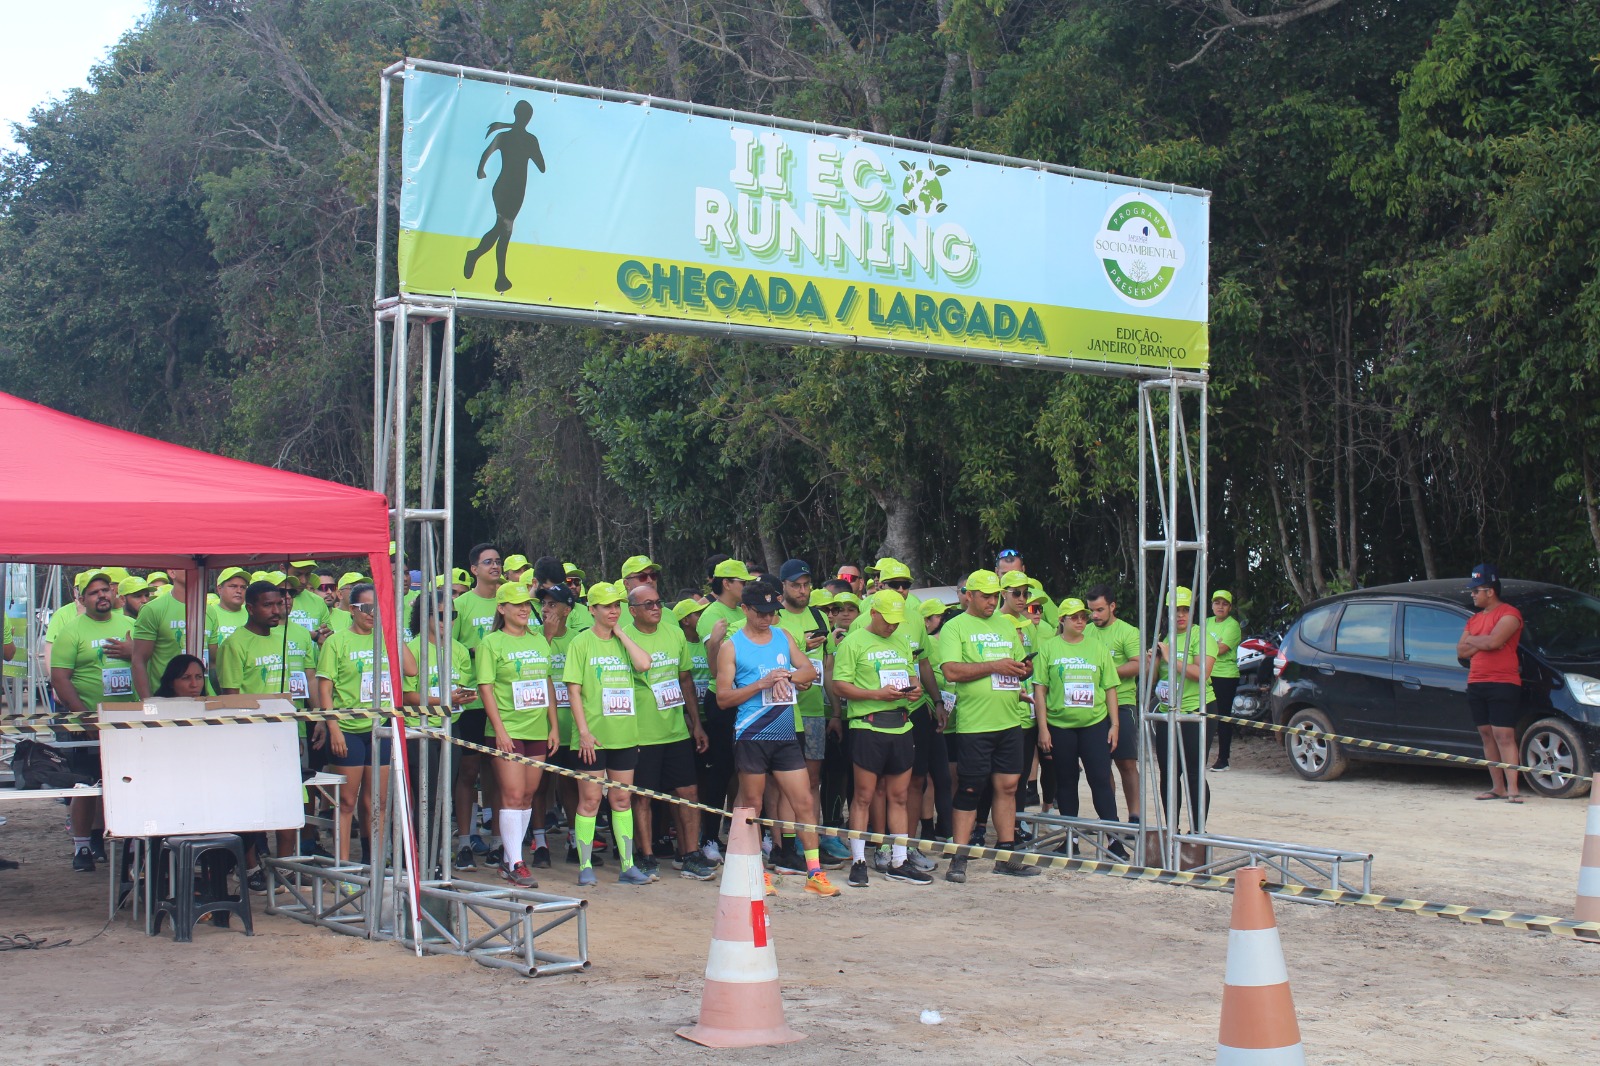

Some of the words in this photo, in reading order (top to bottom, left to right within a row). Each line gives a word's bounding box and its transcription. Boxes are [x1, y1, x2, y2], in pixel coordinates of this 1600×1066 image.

[730, 128, 792, 198] II
[1113, 207, 1166, 232] PROGRAMA
[695, 186, 978, 284] RUNNING
[1095, 239, 1178, 260] SOCIOAMBIENTAL
[1110, 268, 1164, 297] PRESERVAR
[616, 259, 825, 321] CHEGADA
[868, 287, 1047, 344] LARGADA
[1116, 327, 1162, 345] EDIÇÃO:
[1088, 339, 1137, 355] JANEIRO
[1140, 343, 1187, 360] BRANCO
[111, 675, 130, 688] 084
[523, 687, 545, 702] 042
[609, 695, 630, 709] 003
[661, 687, 680, 702] 100
[1073, 689, 1092, 701] 027
